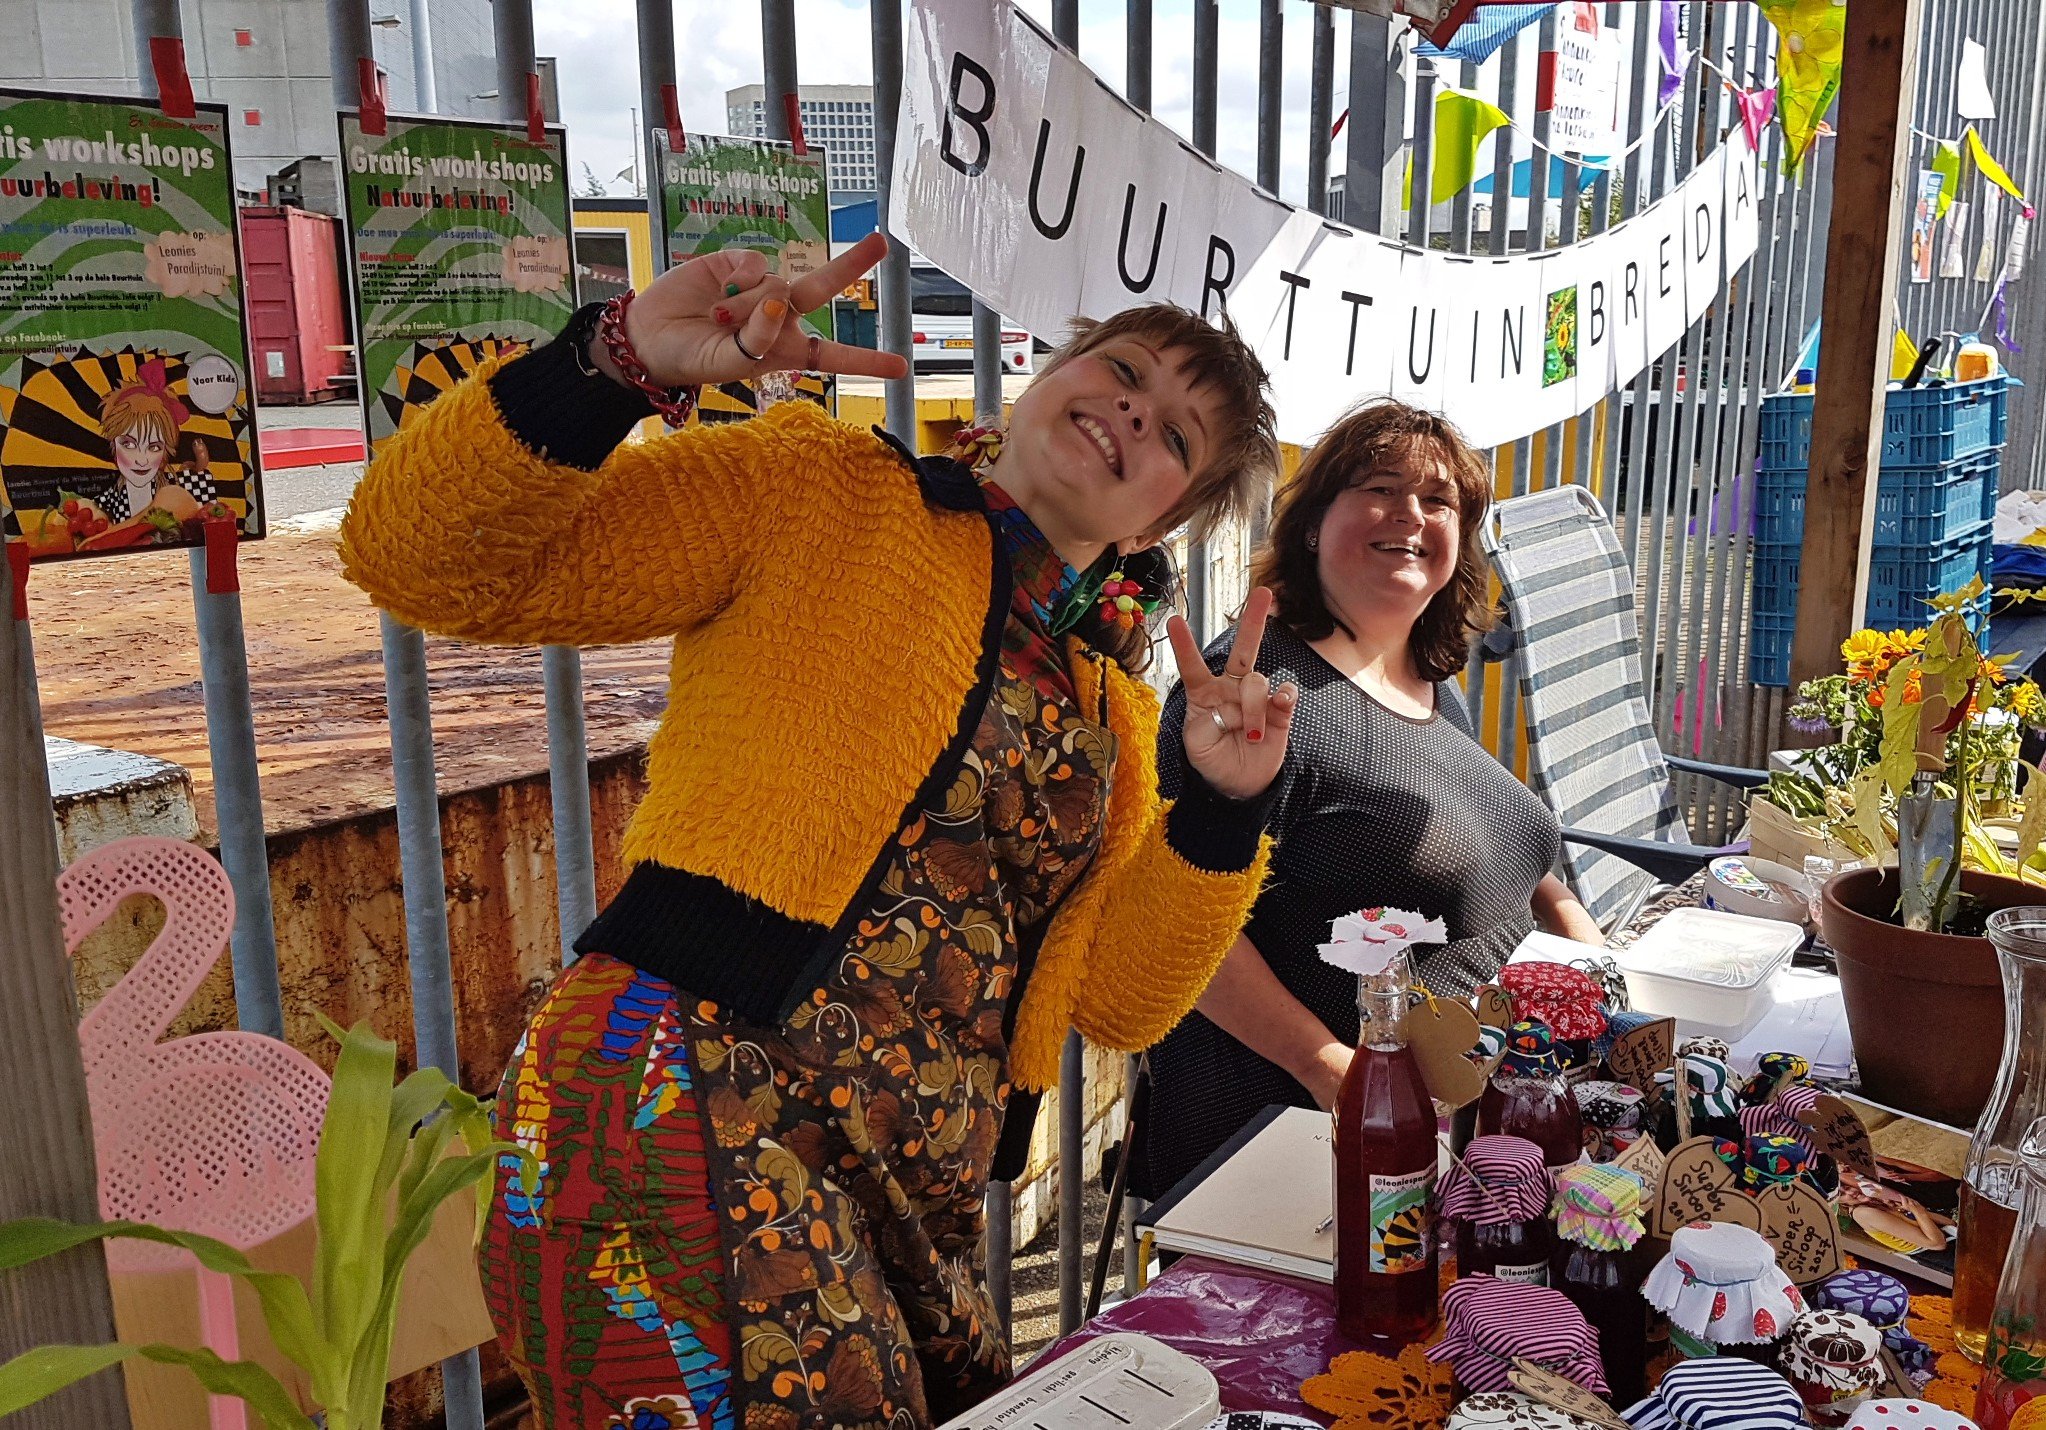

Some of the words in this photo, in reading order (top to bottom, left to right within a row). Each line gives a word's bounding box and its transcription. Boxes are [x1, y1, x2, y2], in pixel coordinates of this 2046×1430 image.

[43, 131, 214, 177] workshops
[352, 146, 424, 177] Gratis
[430, 150, 554, 190] workshops
[0, 171, 161, 208] uurbeleving!
[666, 158, 721, 187] Gratis
[727, 165, 819, 200] workshops
[366, 184, 515, 217] Natuurbeleving!
[159, 245, 197, 257] Leonies
[193, 231, 207, 240] op:
[167, 262, 226, 276] Paradijstuin!
[1591, 160, 1749, 346] BREDA
[193, 377, 214, 386] Voor
[216, 375, 236, 384] Kids
[1808, 1238, 1831, 1274] 2017
[1088, 1346, 1123, 1366] kleding
